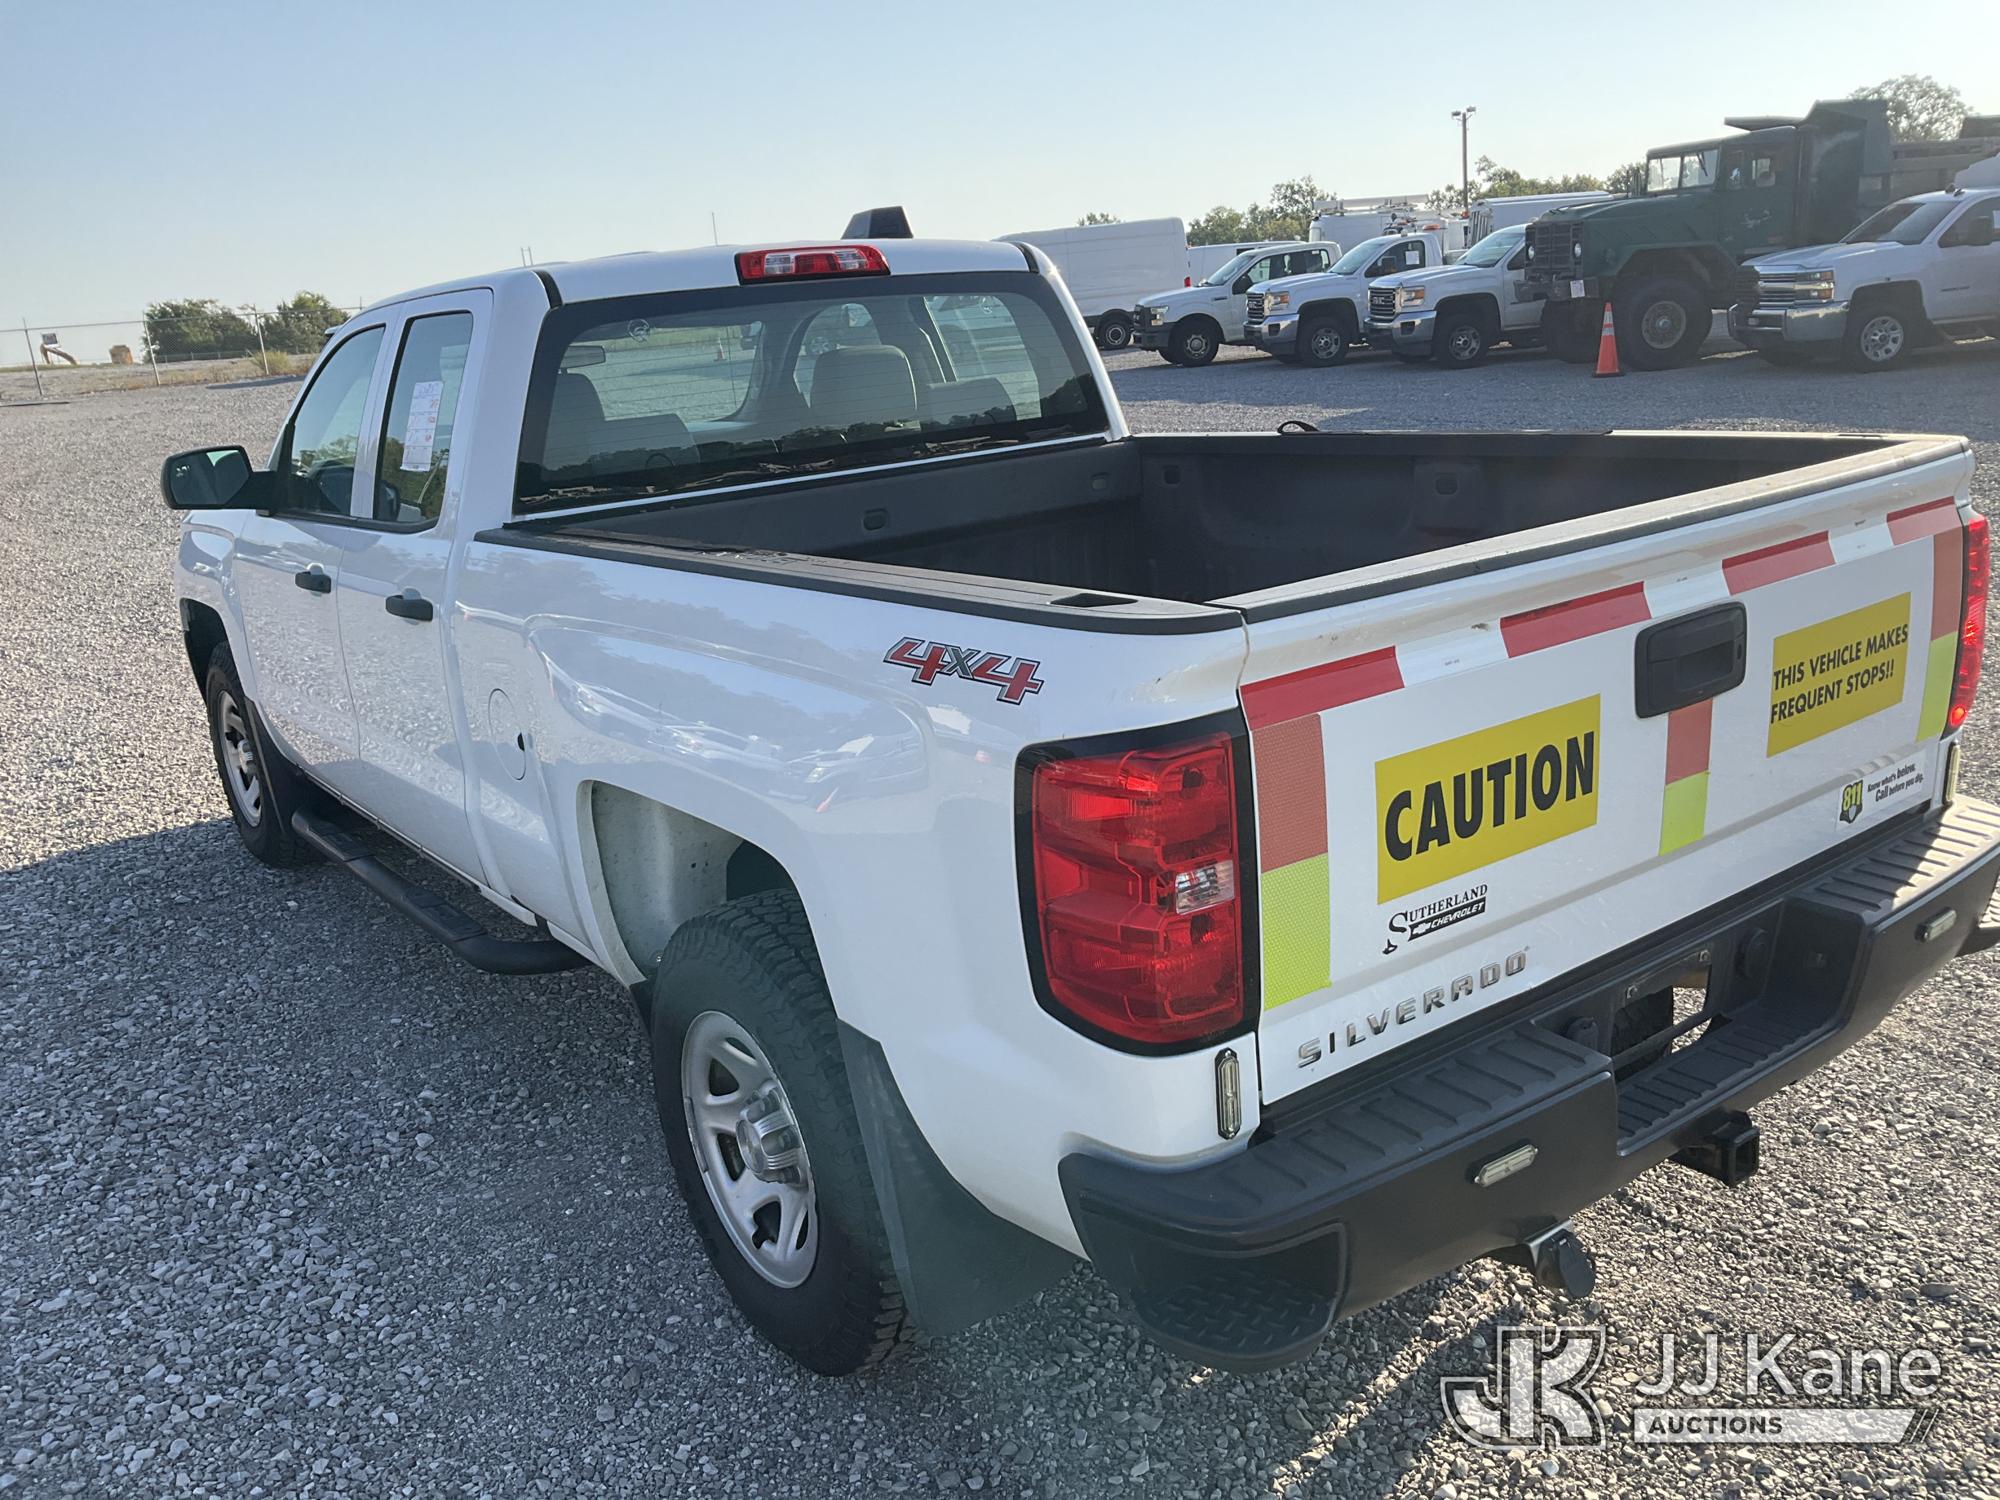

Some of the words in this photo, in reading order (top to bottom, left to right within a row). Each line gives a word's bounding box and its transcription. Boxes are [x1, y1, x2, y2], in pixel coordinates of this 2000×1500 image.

[1773, 662, 1805, 690] THIS
[1809, 640, 1863, 677] VEHICLE
[1865, 623, 1908, 658] MAKES
[1770, 679, 1843, 724] FREQUENT
[1845, 658, 1895, 695] STOPS!!
[1384, 730, 1595, 862] CAUTION
[1842, 780, 1863, 812] 811
[1875, 785, 1889, 802] Call
[1430, 900, 1484, 930] CHEVROLET
[1298, 950, 1526, 1069] SILVERADO
